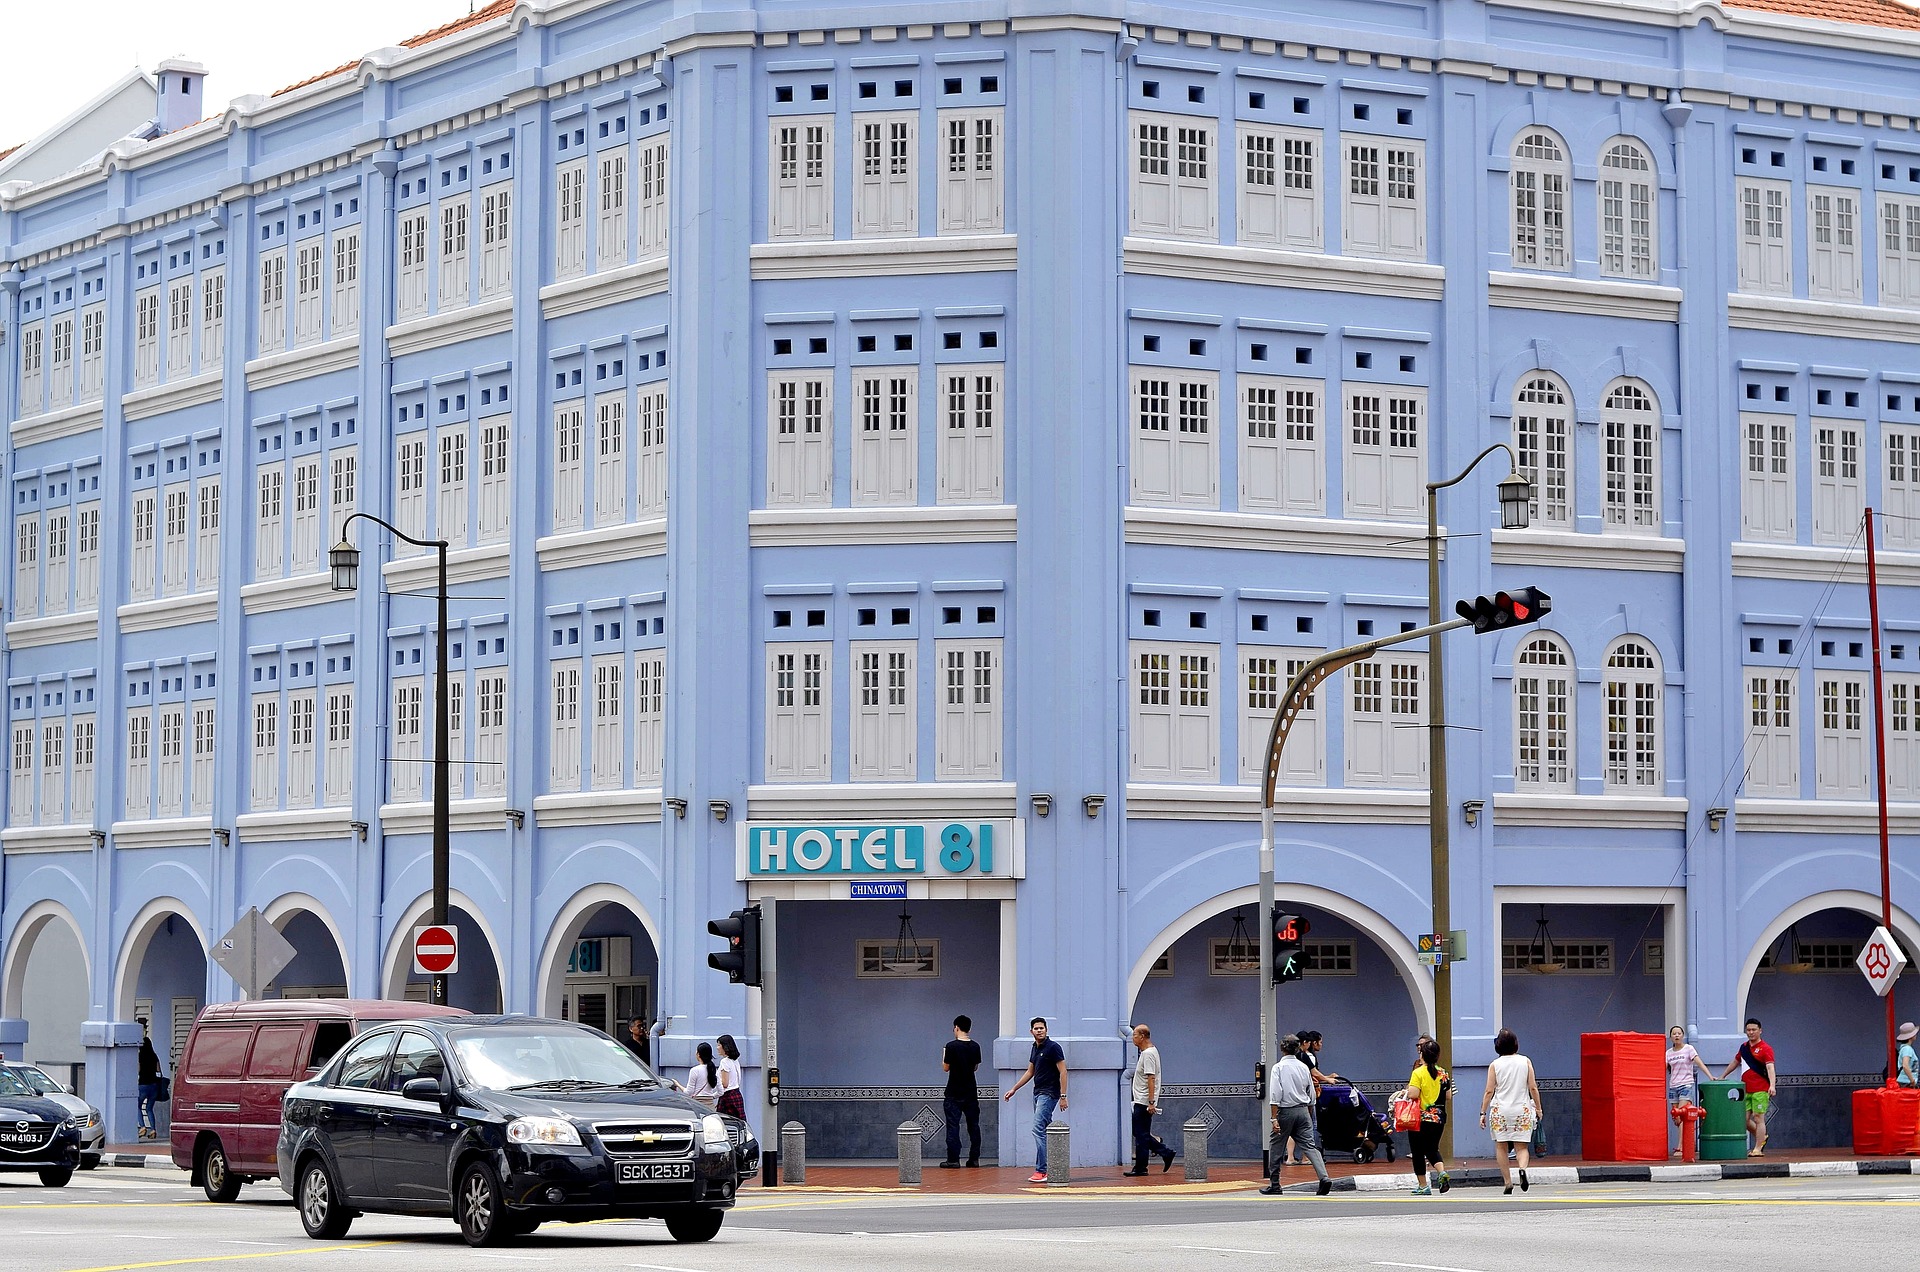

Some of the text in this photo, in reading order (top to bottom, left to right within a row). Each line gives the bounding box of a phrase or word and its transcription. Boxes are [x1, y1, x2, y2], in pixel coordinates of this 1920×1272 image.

[760, 823, 993, 872] HOTEL 81
[851, 885, 905, 895] CHINATOWN
[579, 940, 601, 972] 81
[622, 1164, 691, 1179] SGK1253P
